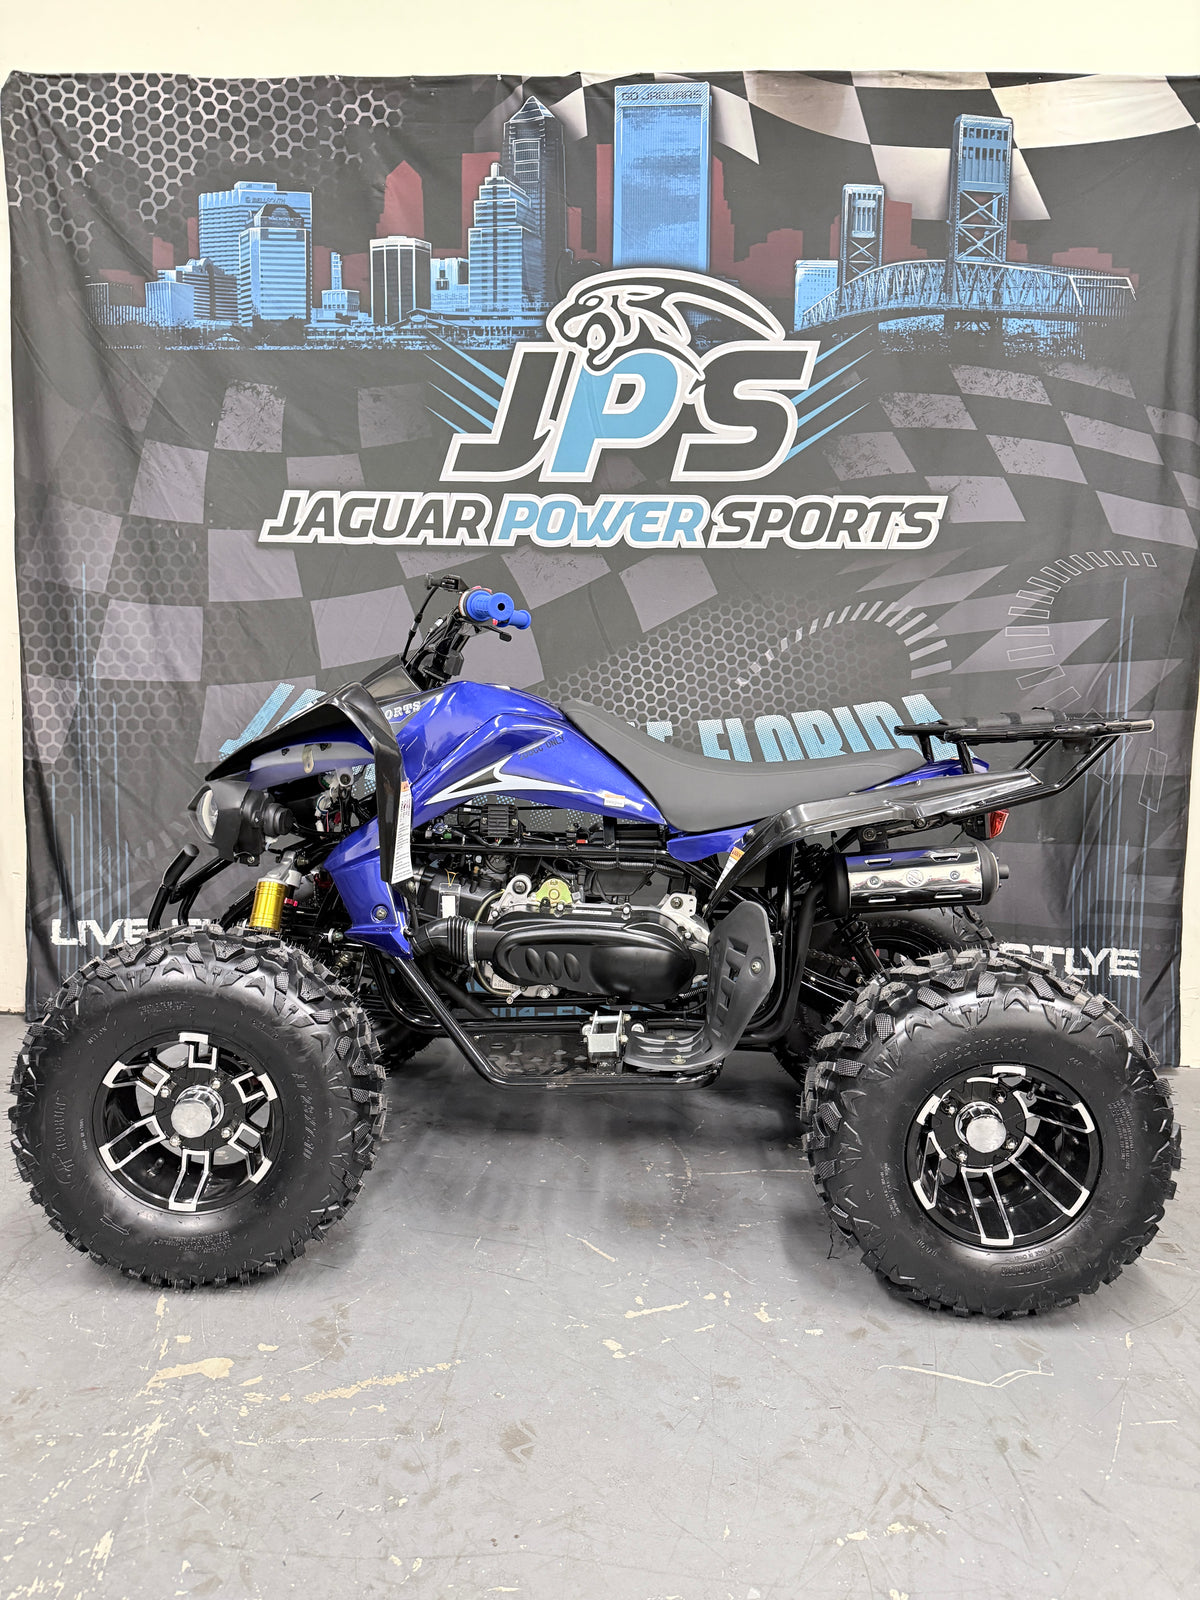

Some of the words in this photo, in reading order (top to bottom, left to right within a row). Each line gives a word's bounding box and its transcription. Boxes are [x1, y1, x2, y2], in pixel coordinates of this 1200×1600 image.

[641, 88, 702, 101] JAGUARS
[440, 340, 820, 483] JPS
[260, 490, 490, 544] JAGUAR
[493, 496, 708, 545] POWER
[707, 496, 947, 546] SPORTS
[545, 735, 566, 749] ONLY
[51, 918, 149, 946] LIVE
